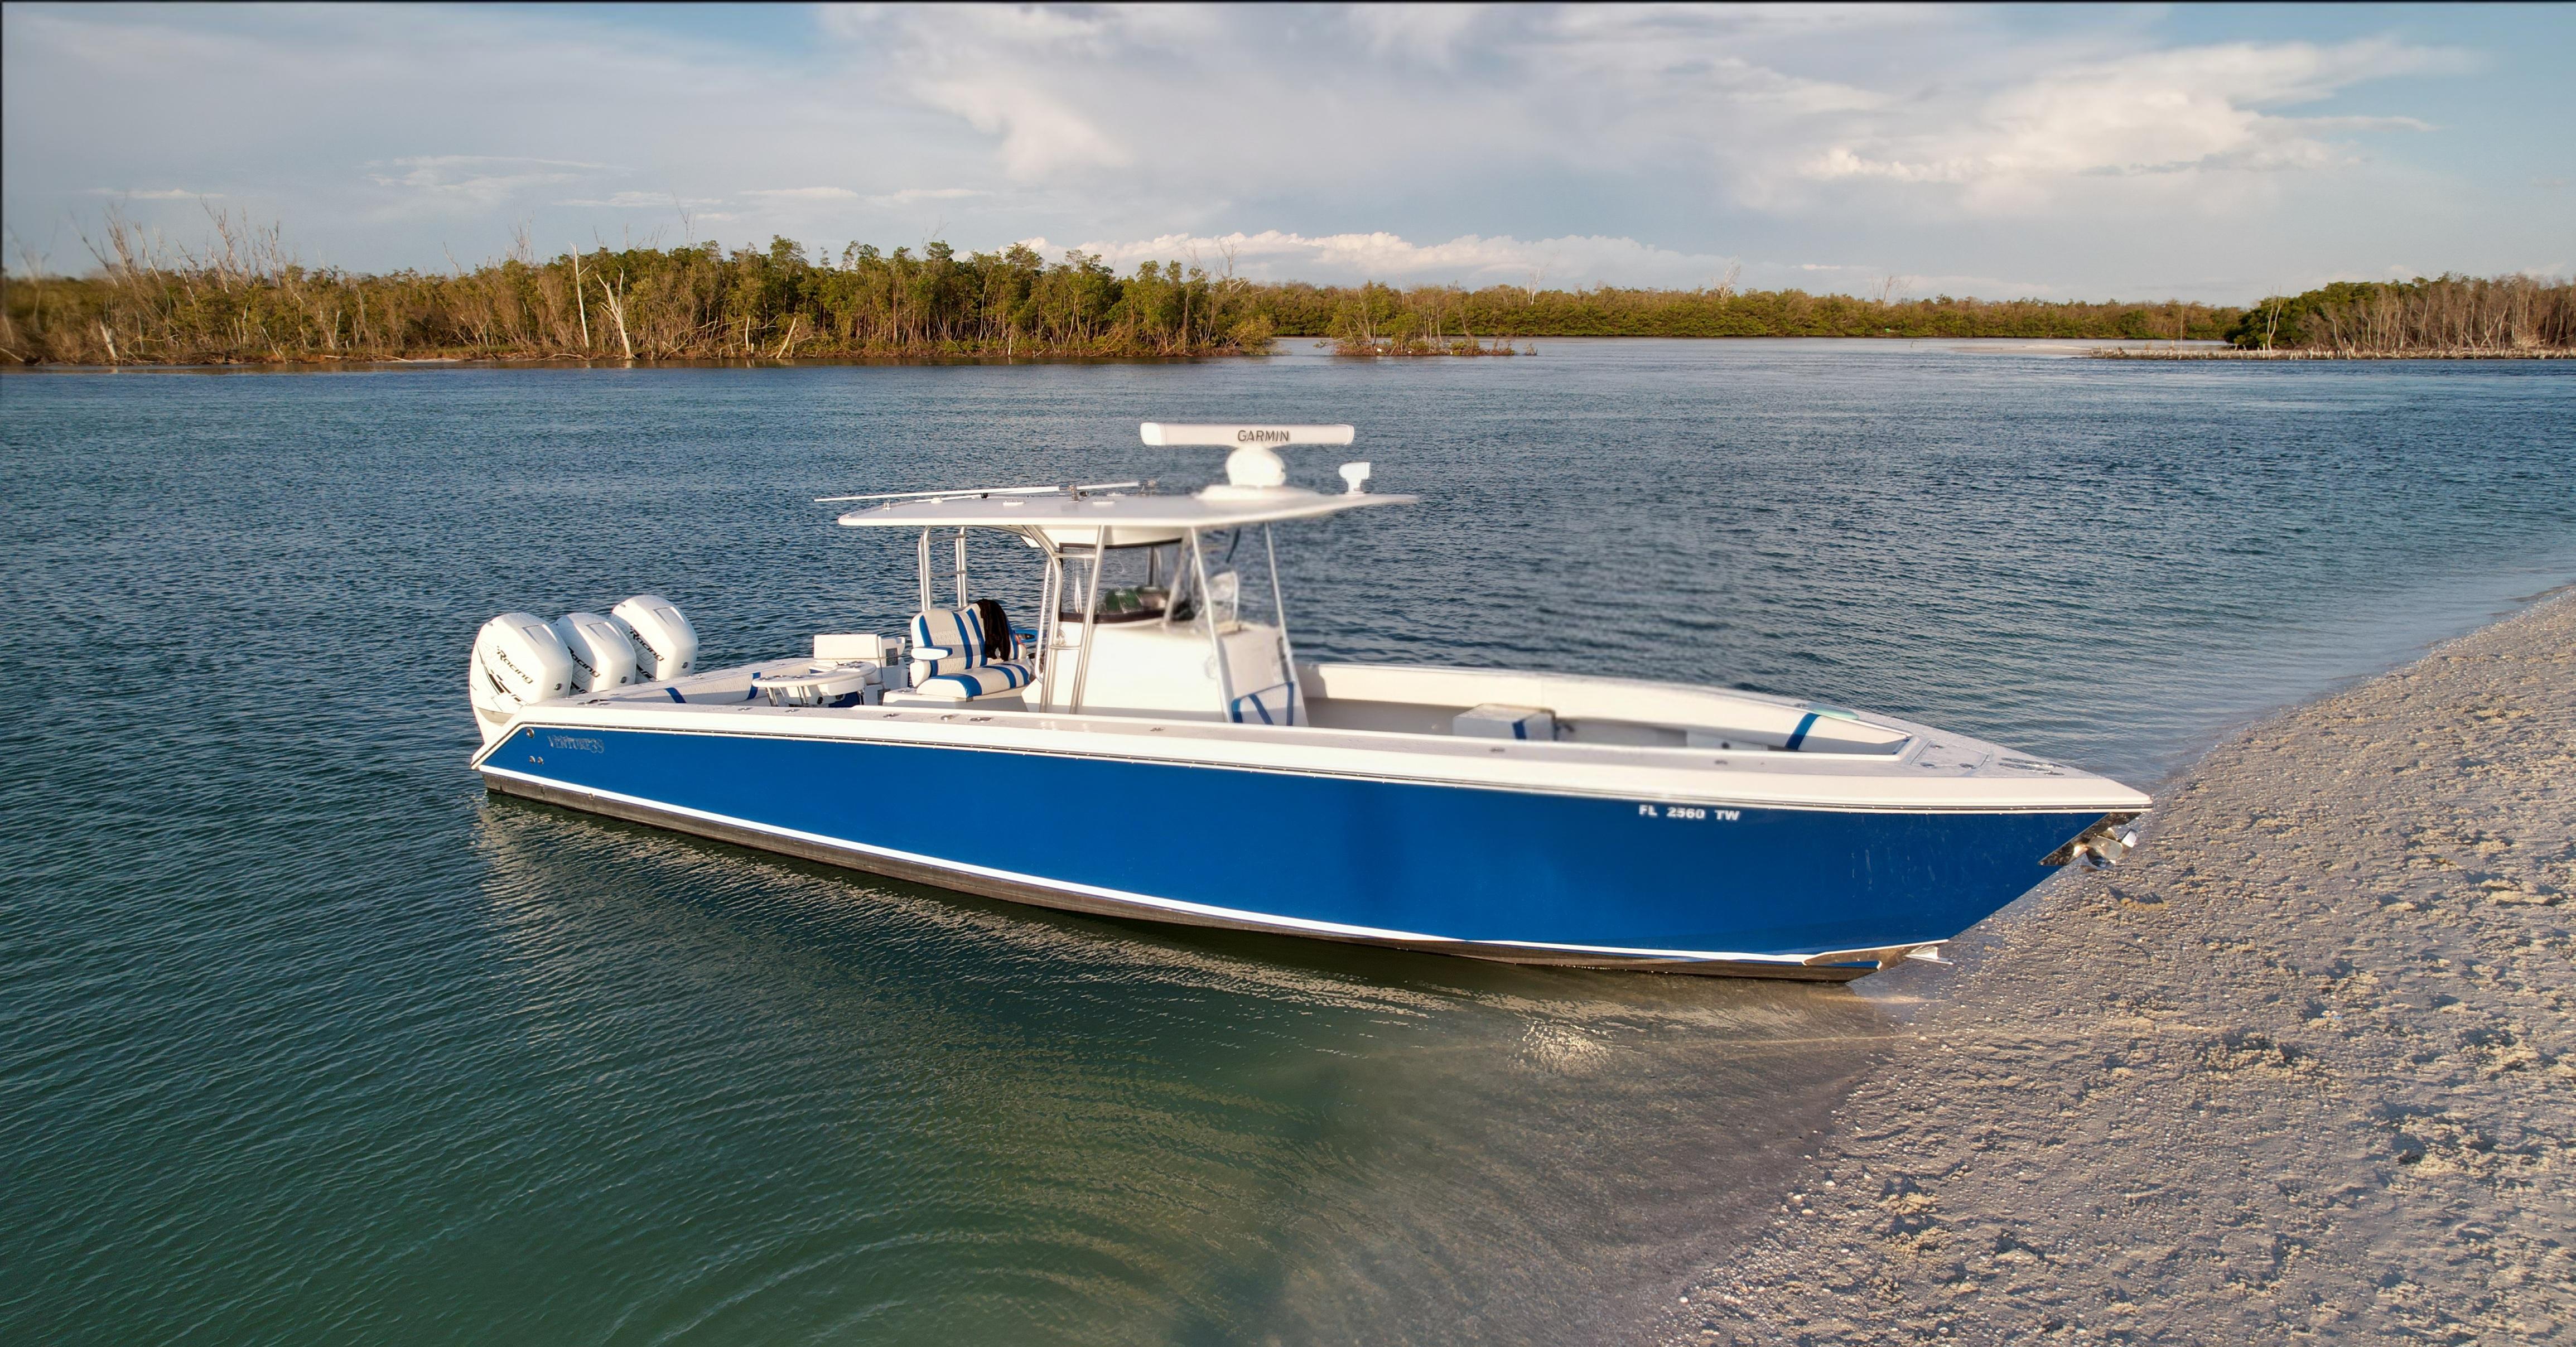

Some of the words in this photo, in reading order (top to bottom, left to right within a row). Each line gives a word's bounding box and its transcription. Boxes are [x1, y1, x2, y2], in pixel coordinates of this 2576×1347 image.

[1237, 429, 1290, 442] GARMIN
[629, 625, 664, 662] Racing
[496, 645, 534, 684] Racing
[1639, 805, 1658, 817] FL
[1666, 807, 1706, 819] 2560
[1714, 809, 1741, 821] TW
